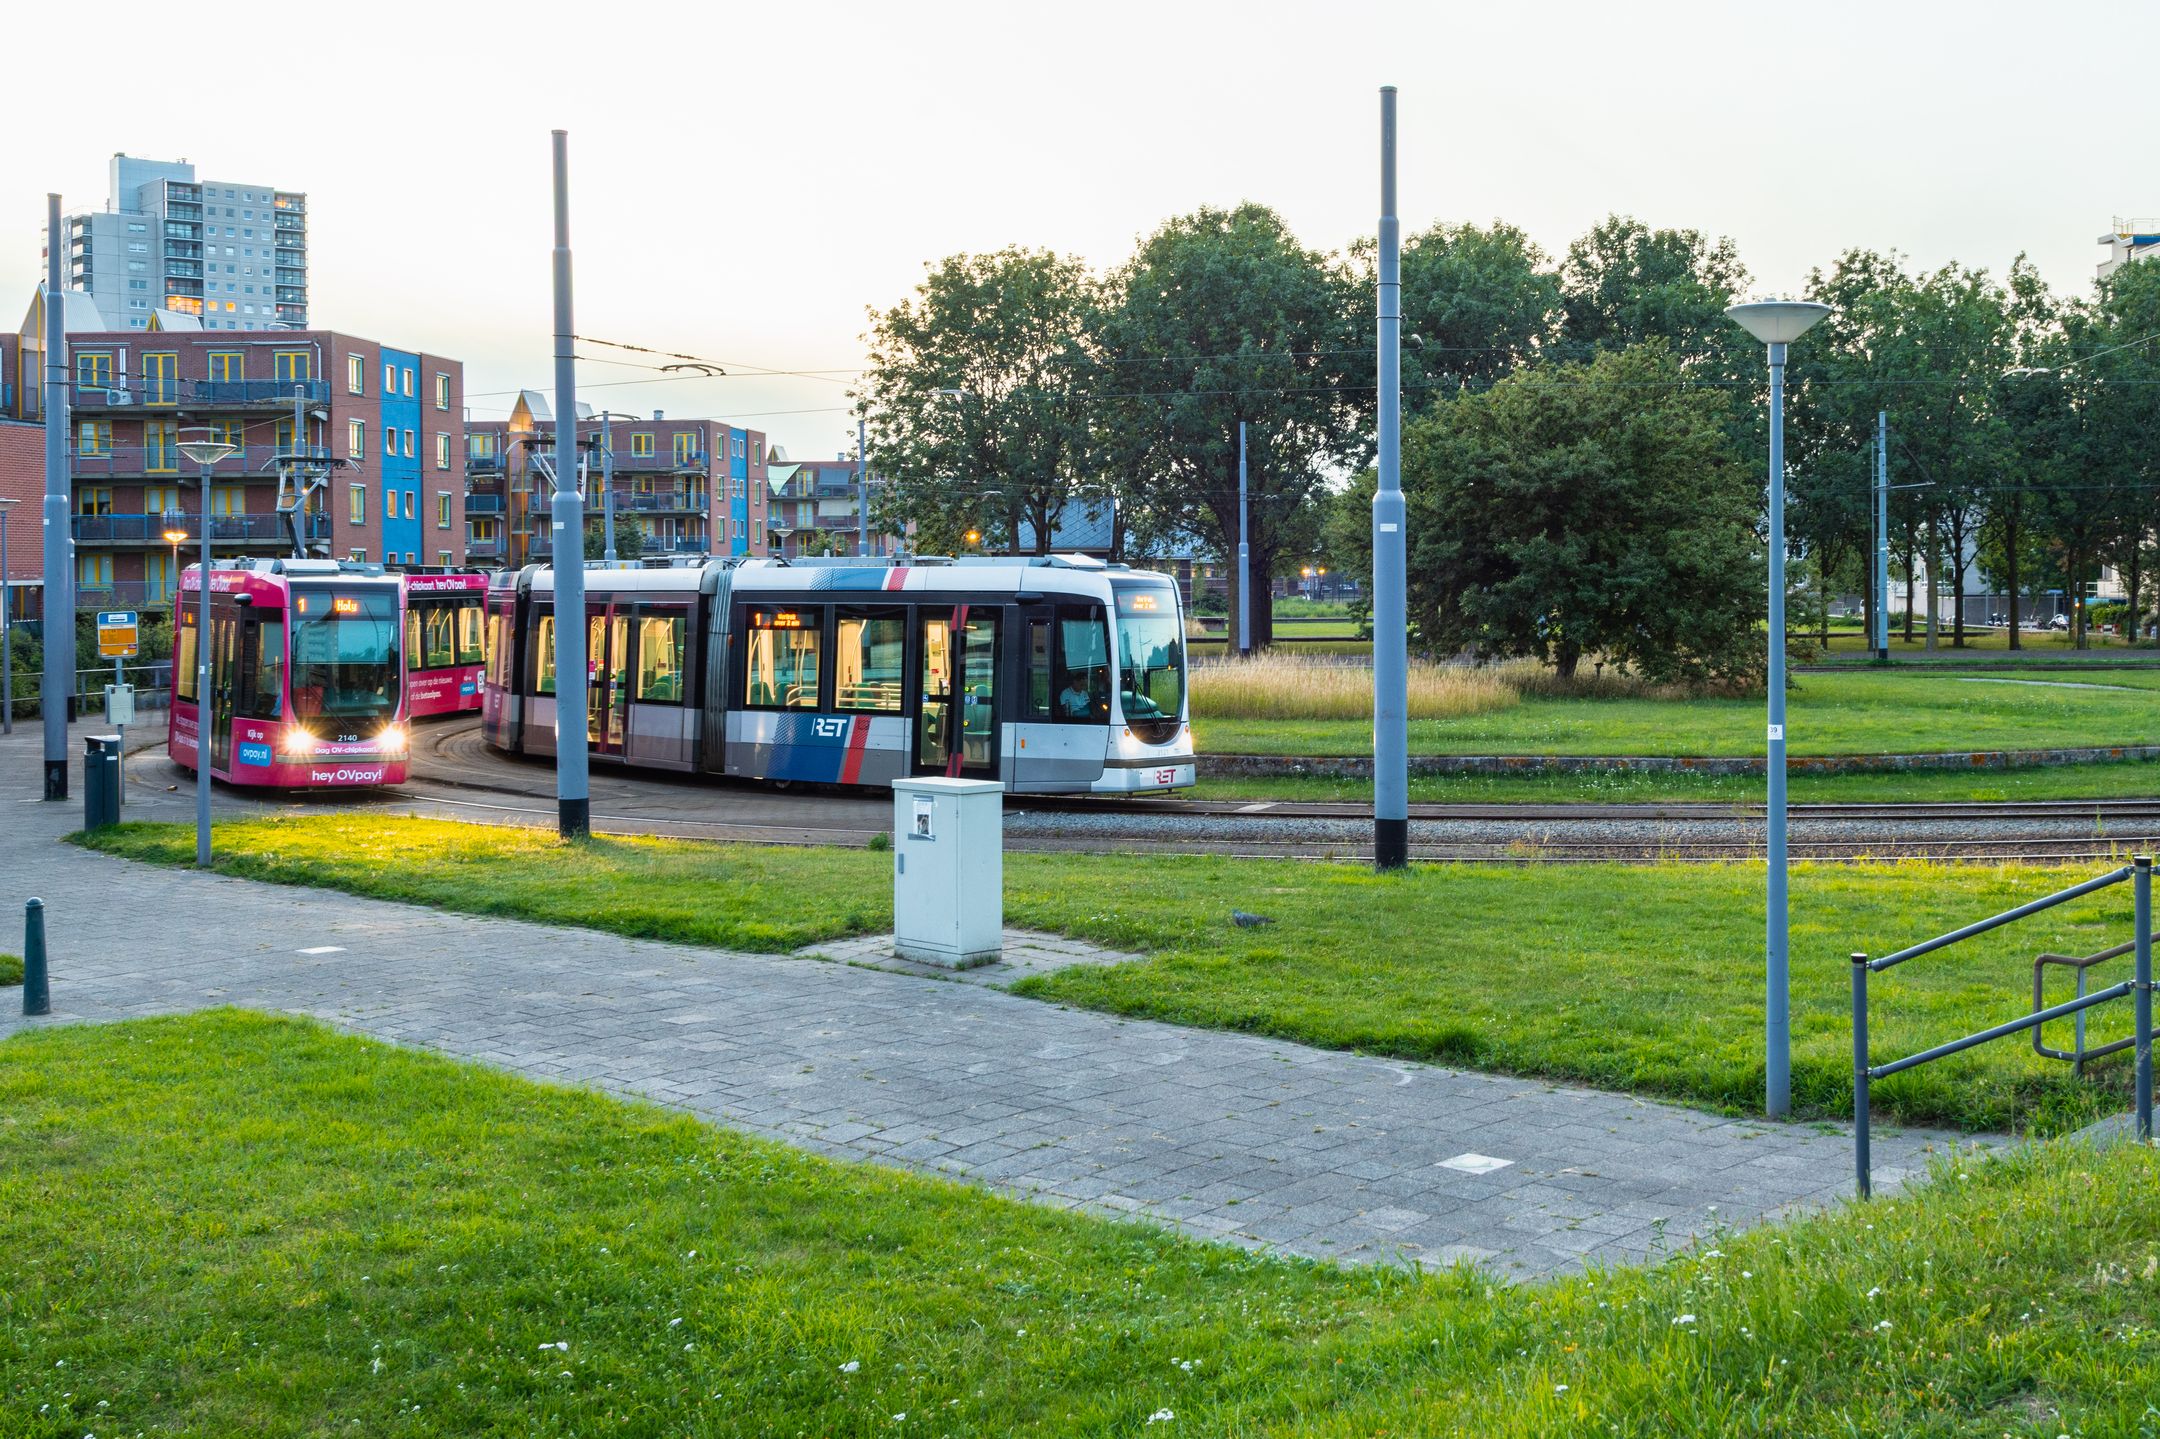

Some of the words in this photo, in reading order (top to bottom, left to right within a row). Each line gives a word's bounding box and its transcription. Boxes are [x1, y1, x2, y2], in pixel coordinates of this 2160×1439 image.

[298, 598, 305, 612] 1
[336, 599, 358, 612] Holy
[755, 613, 761, 626] 1
[811, 718, 848, 737] RET
[338, 734, 358, 742] 2140
[243, 748, 268, 760] ovpay.nl
[312, 770, 335, 782] hey
[336, 769, 382, 782] OVpay!
[1153, 768, 1176, 784] RET
